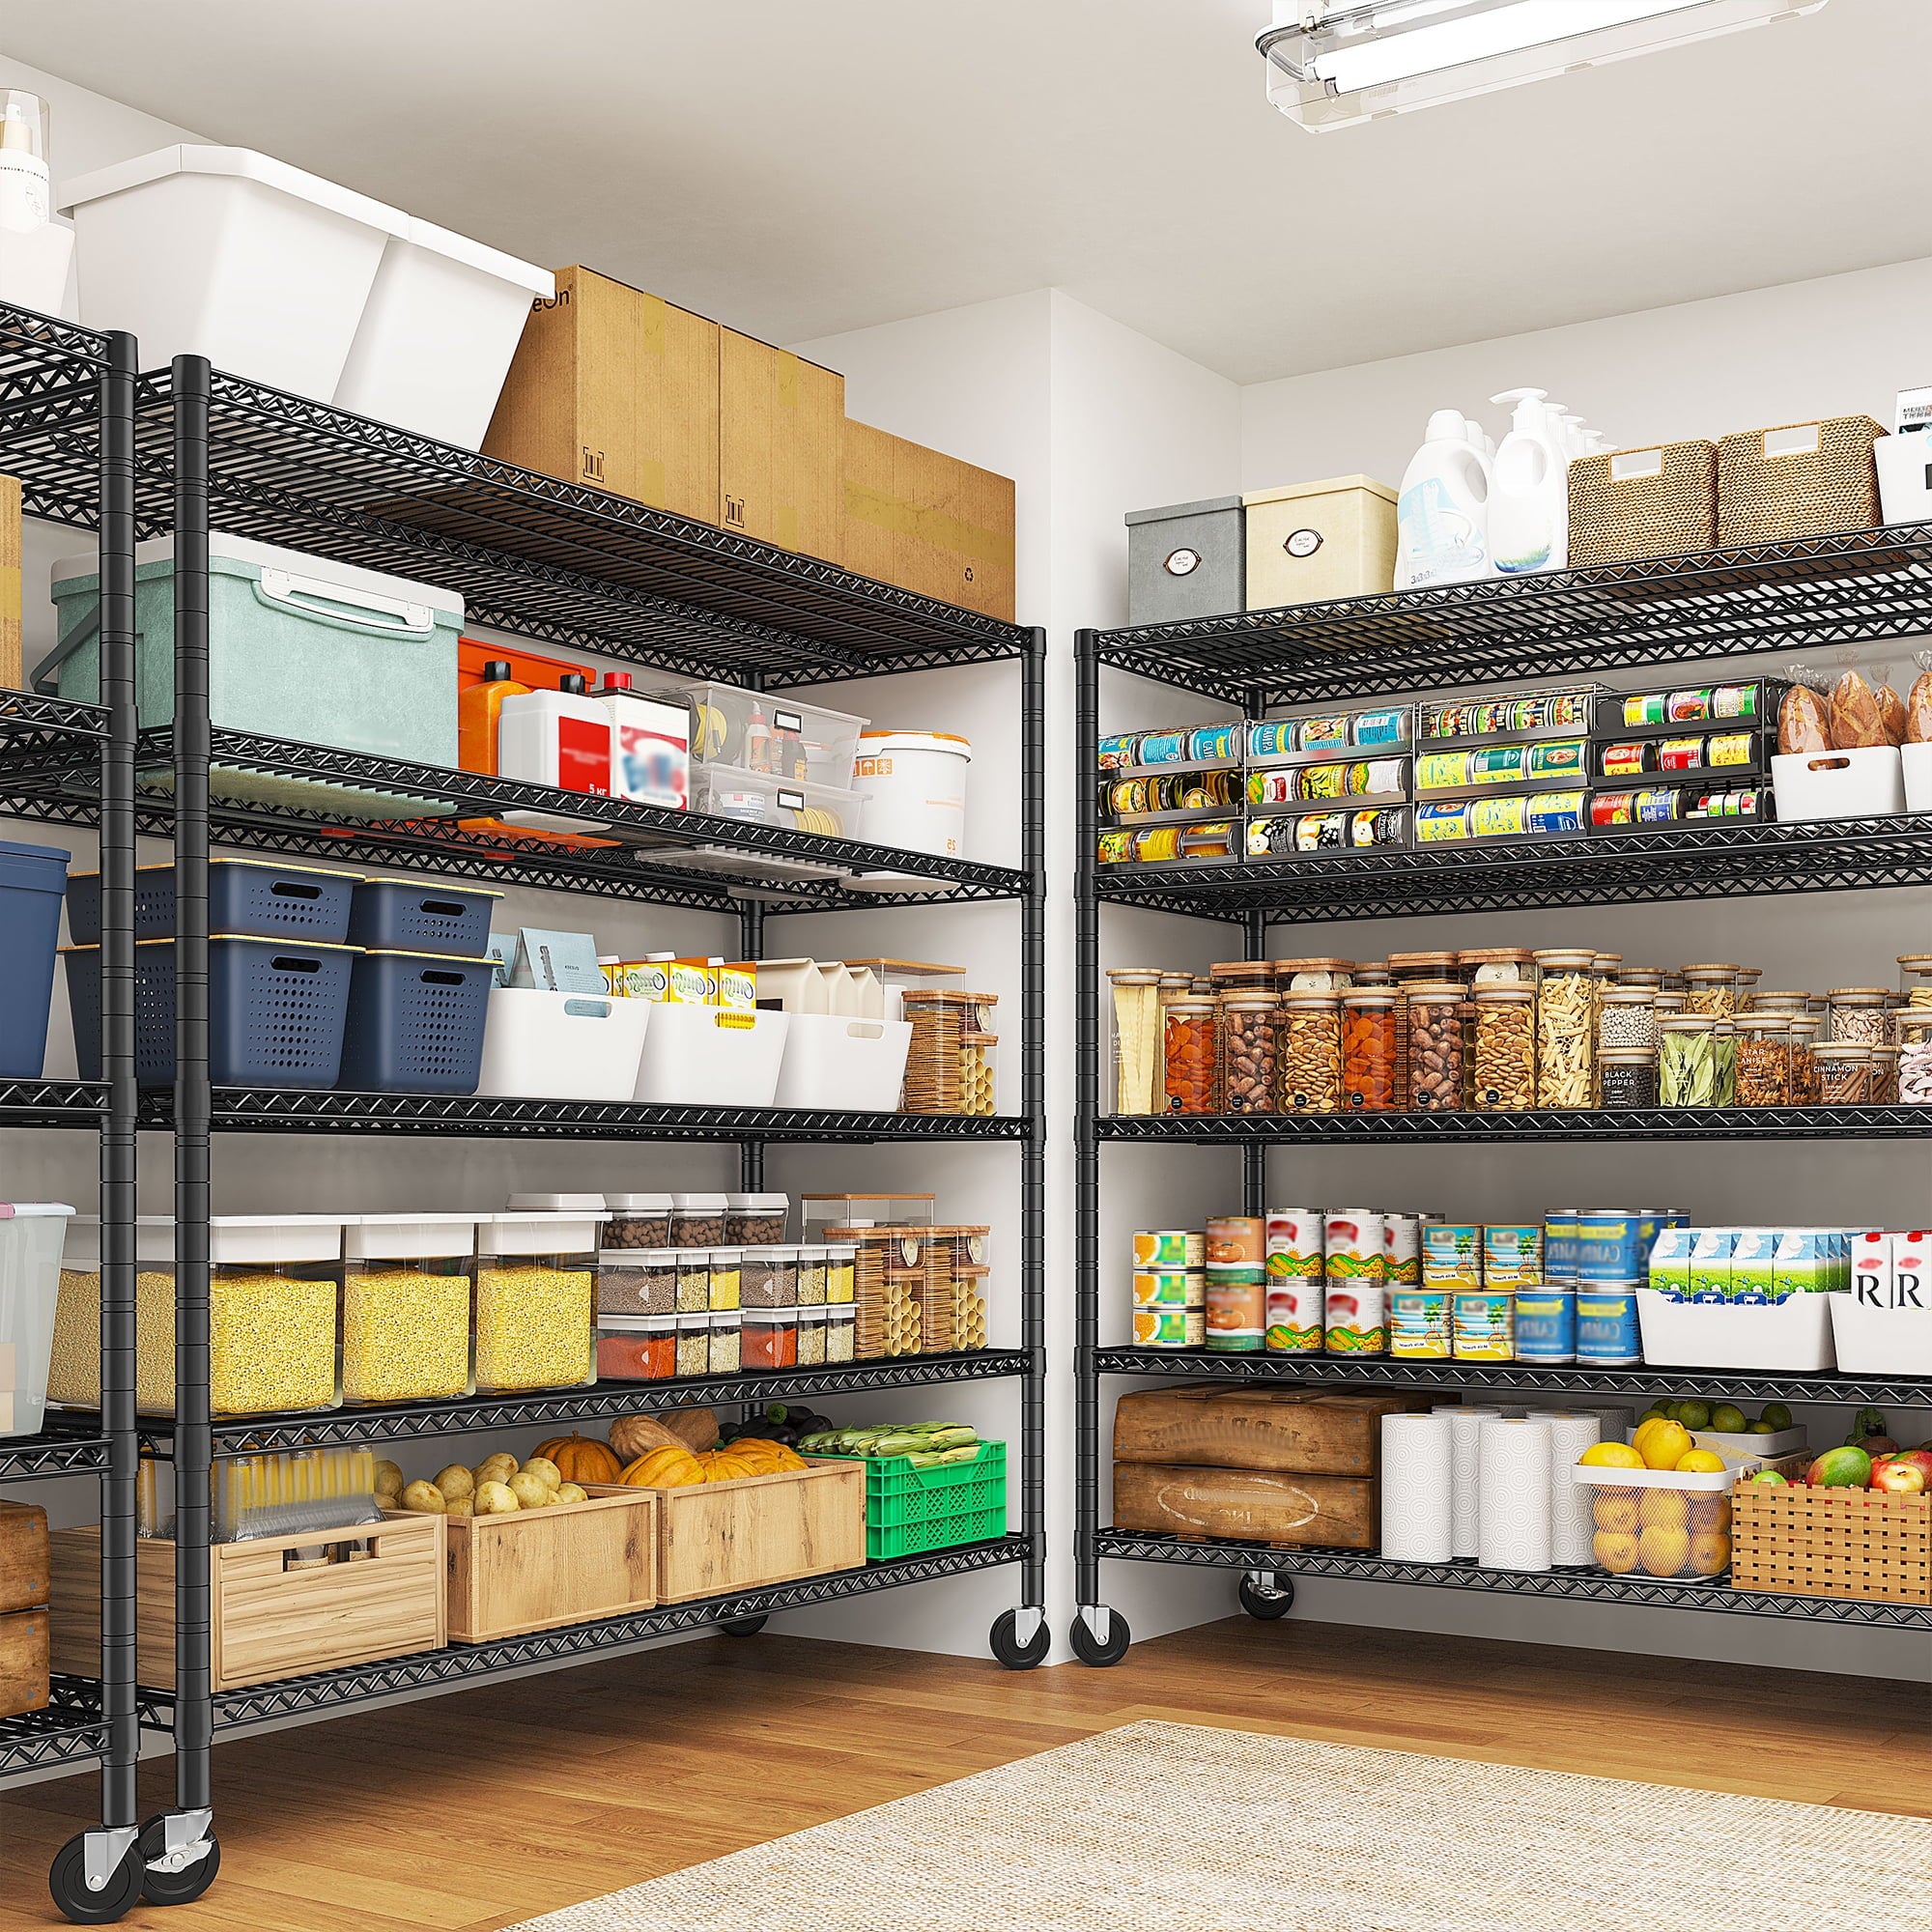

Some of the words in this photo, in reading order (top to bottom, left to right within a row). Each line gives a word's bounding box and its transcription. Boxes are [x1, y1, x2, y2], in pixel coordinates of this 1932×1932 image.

[589, 783, 595, 794] 5
[1814, 1065, 1859, 1073] CINNAMON
[1856, 1274, 1885, 1308] R
[1896, 1273, 1924, 1308] R
